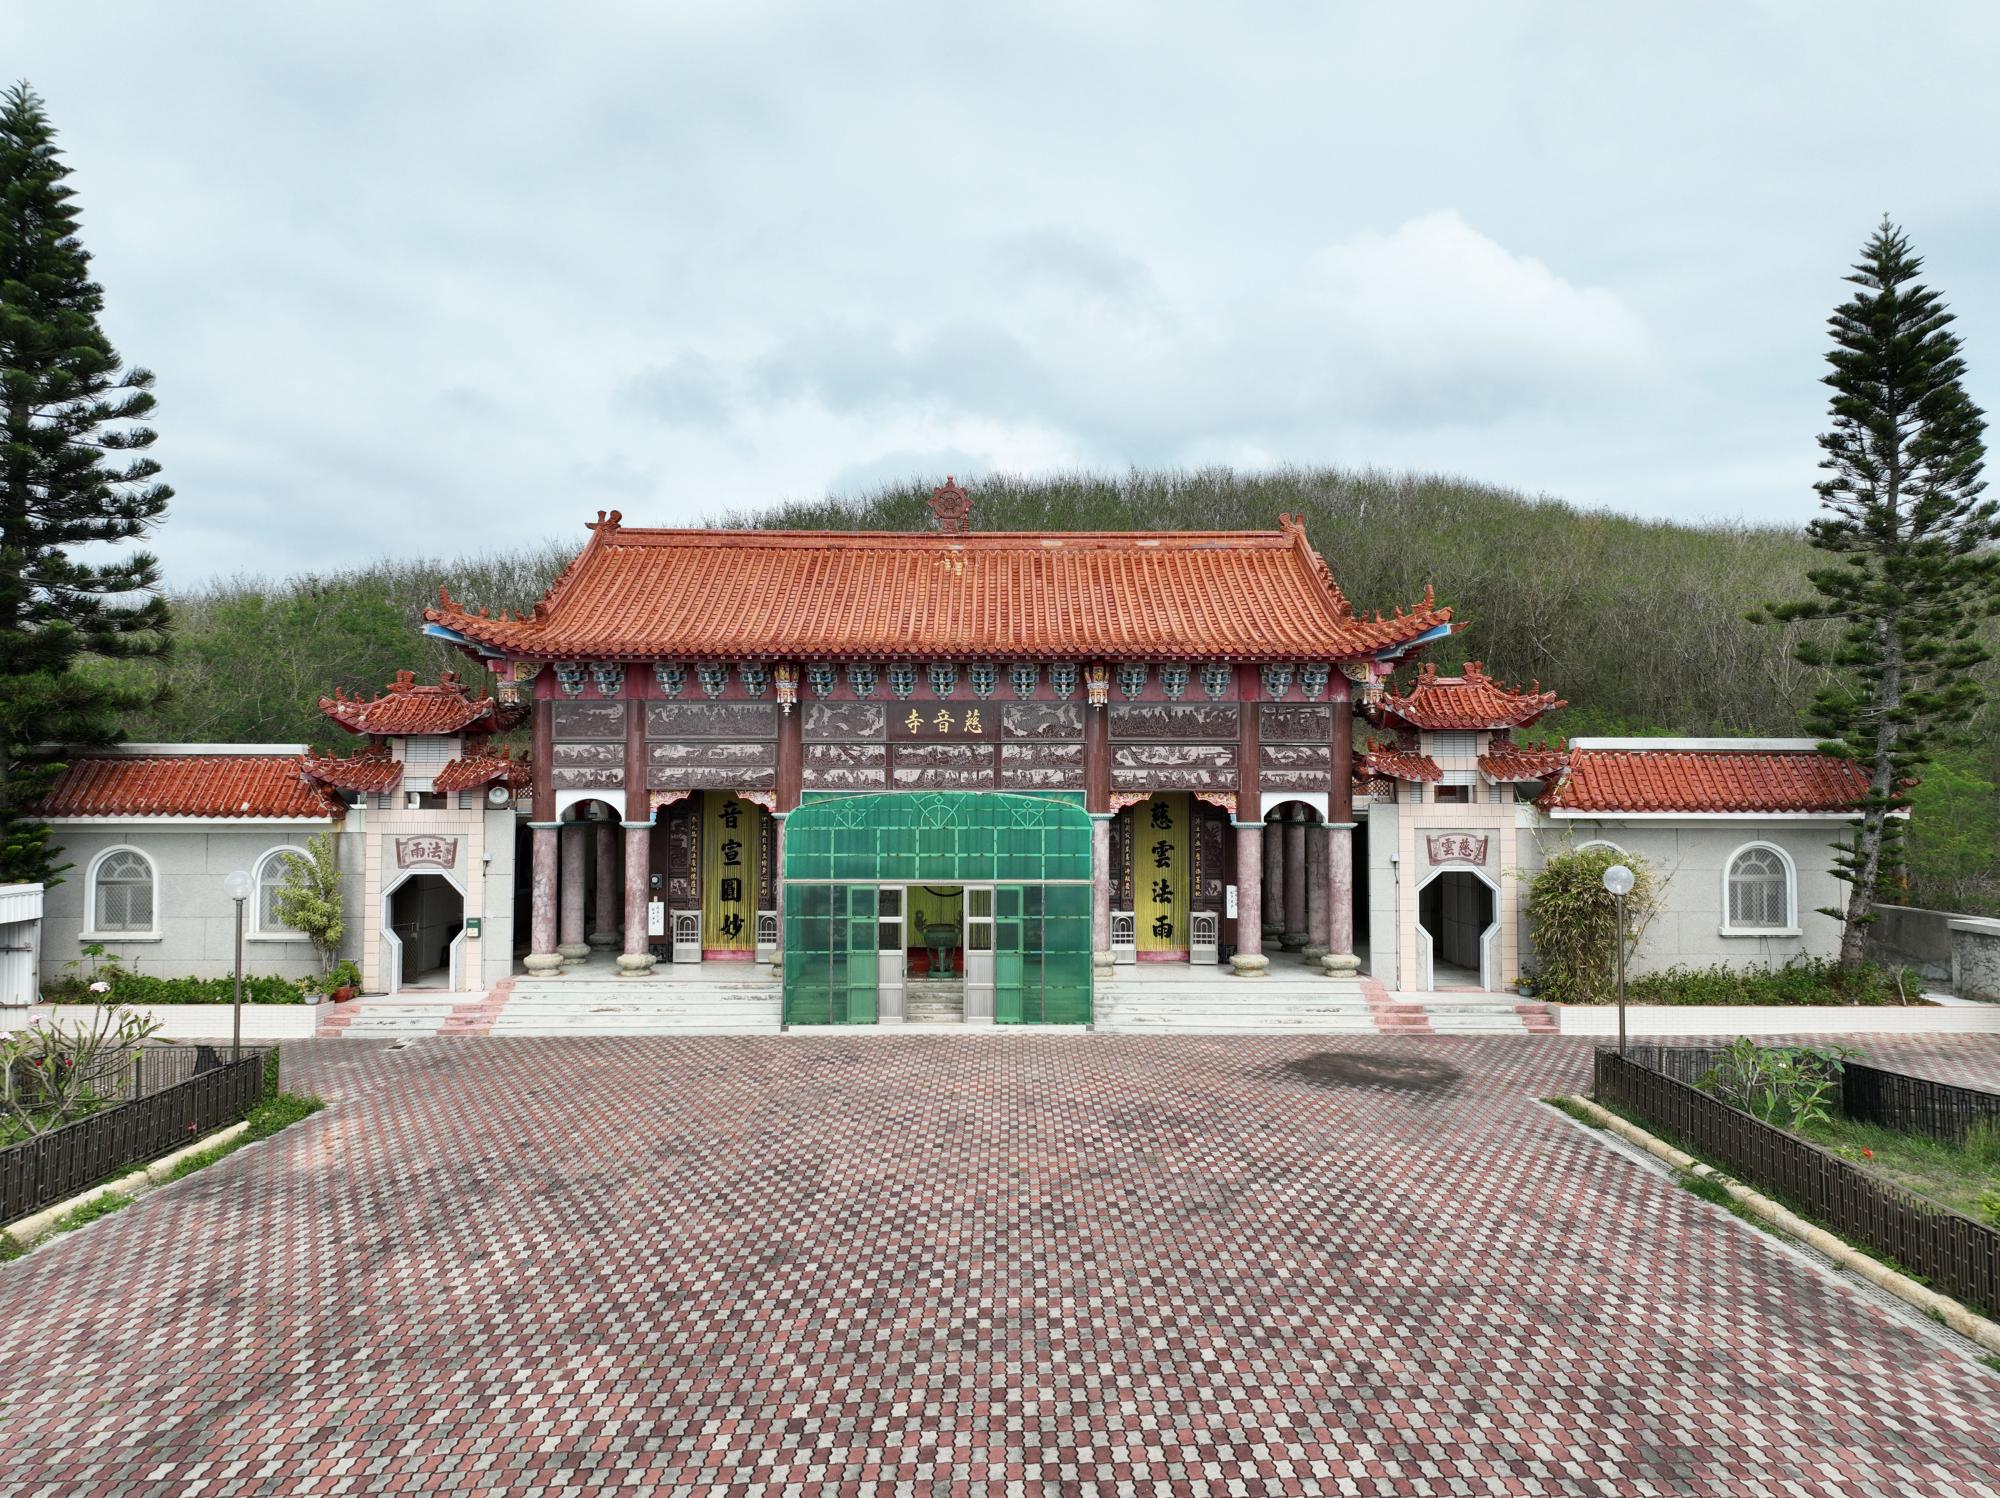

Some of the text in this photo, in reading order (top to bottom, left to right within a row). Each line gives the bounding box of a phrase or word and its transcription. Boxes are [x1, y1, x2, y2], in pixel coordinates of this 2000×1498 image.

[904, 708, 982, 734] 慈音寺
[719, 801, 745, 940] 音宣圓妙
[1151, 802, 1175, 939] 慈雲法雨
